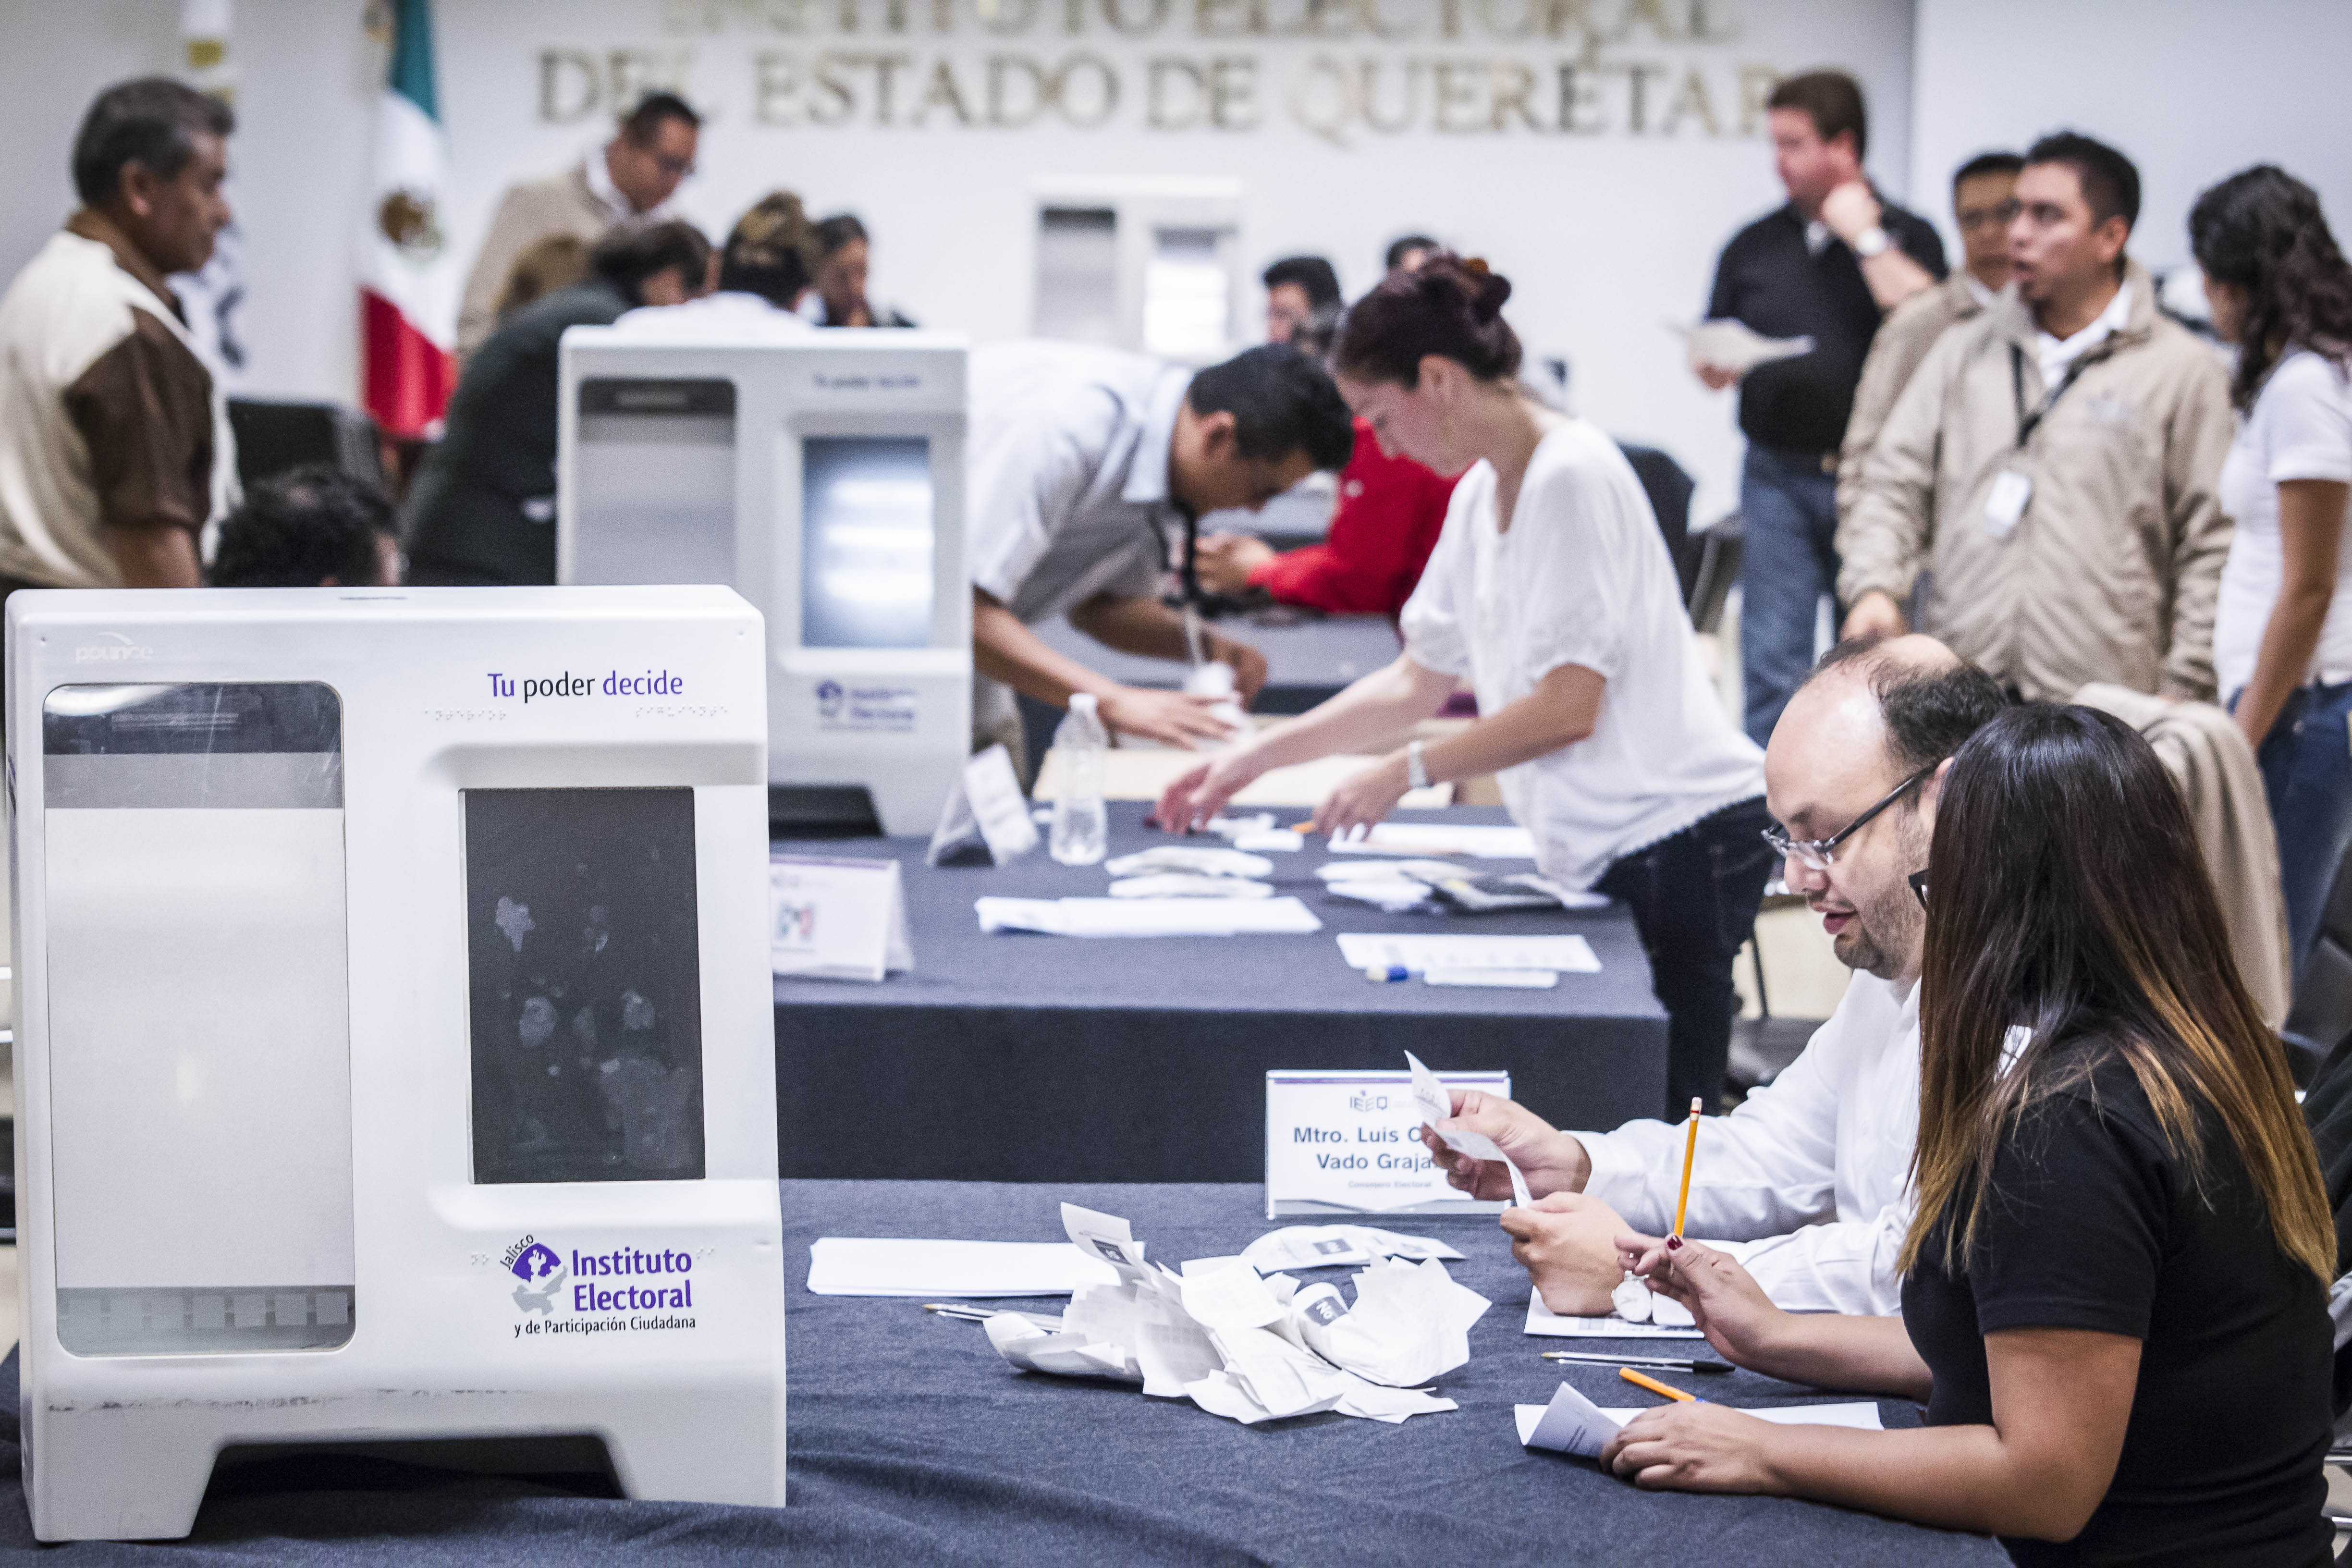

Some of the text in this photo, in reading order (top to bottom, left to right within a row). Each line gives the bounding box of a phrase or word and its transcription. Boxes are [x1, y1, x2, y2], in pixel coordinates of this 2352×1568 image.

[754, 49, 1122, 130] ESTADO
[1146, 53, 1260, 133] DE
[1287, 36, 1780, 149] QUERÉTAR
[487, 670, 683, 703] Tu poder decide
[1294, 1127, 1348, 1143] Mtro.
[1358, 1127, 1399, 1143] Luis
[1316, 1153, 1436, 1173] Vado Graja
[500, 1234, 534, 1270] Jalisco
[572, 1246, 692, 1276] Instituto
[574, 1279, 692, 1311] Electoral
[514, 1315, 696, 1338] y de Participación Ciudadana
